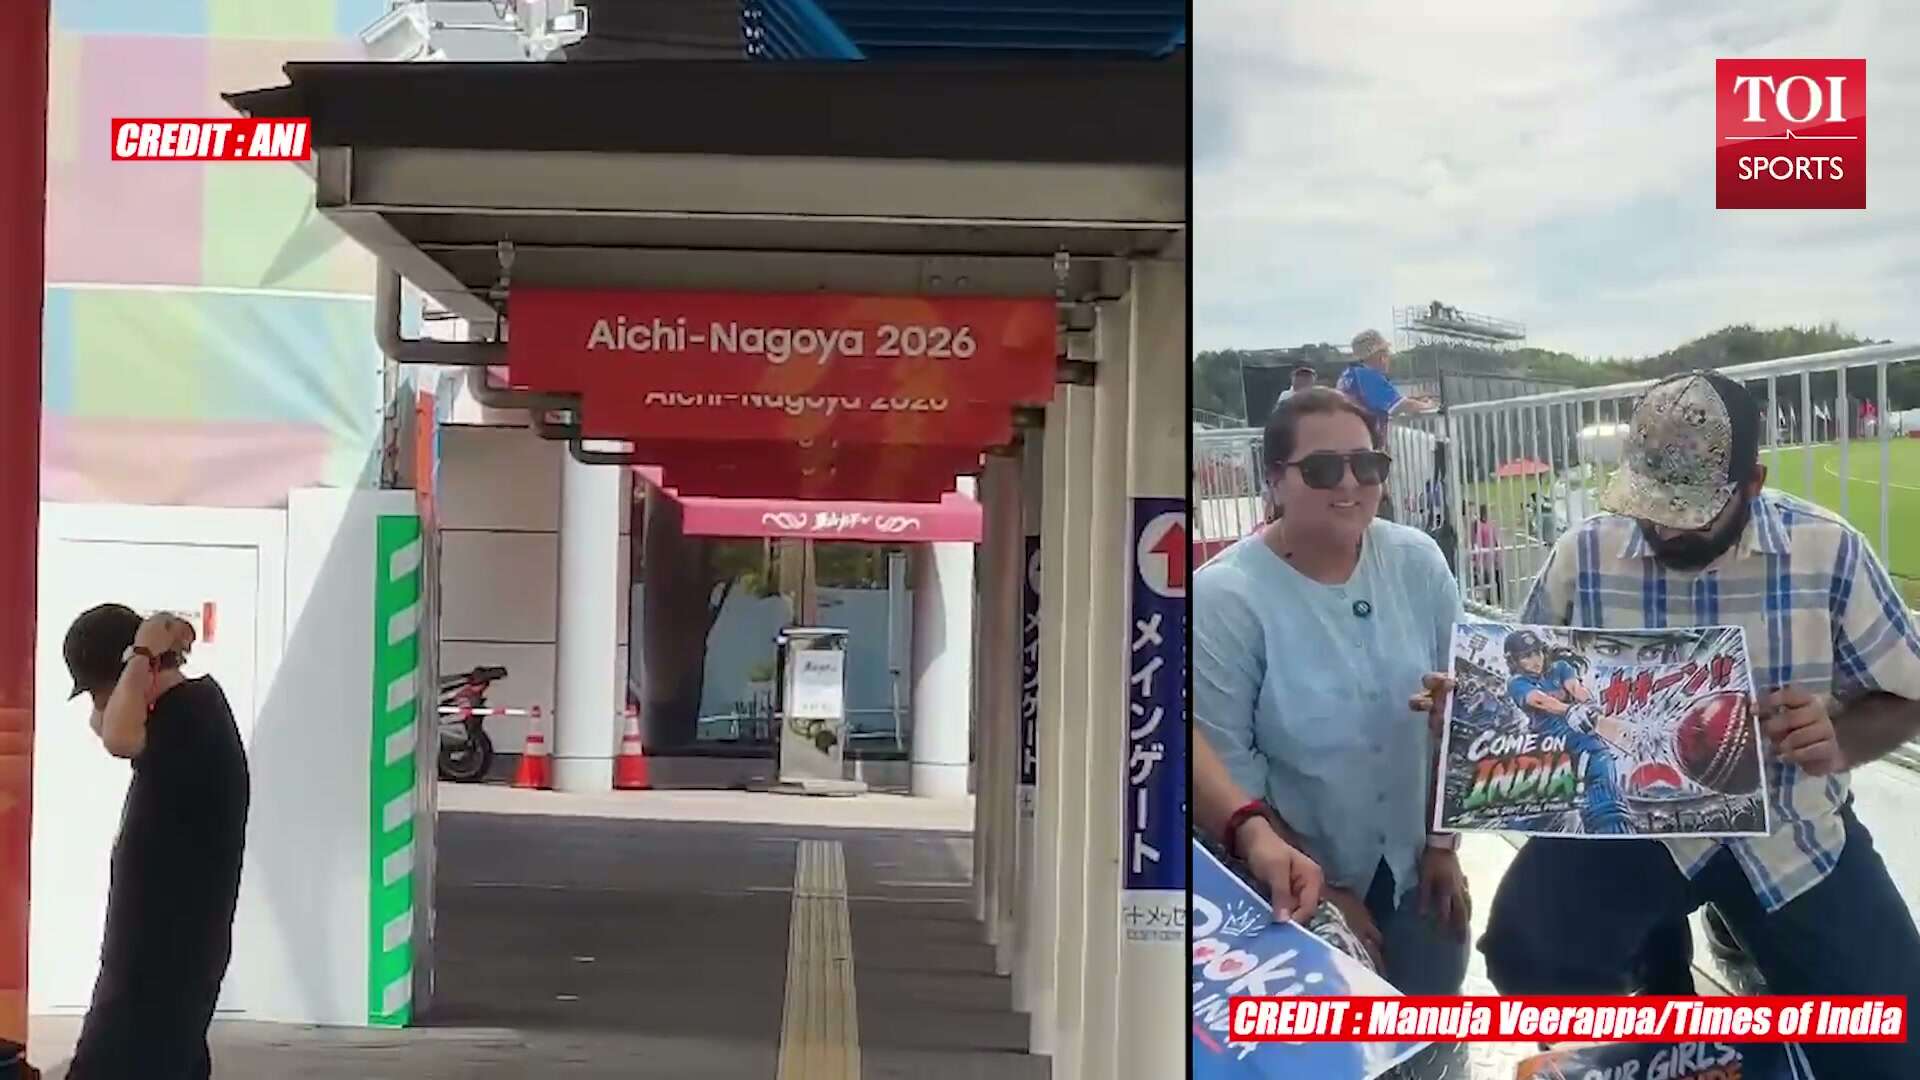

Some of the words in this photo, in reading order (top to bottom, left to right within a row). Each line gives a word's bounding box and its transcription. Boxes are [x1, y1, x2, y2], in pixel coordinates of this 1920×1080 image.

[587, 317, 864, 364] Aichi-Nagoya
[876, 324, 977, 359] 2026
[1130, 613, 1164, 874] メインゲート
[1467, 730, 1539, 761] COME
[1541, 735, 1567, 753] ON
